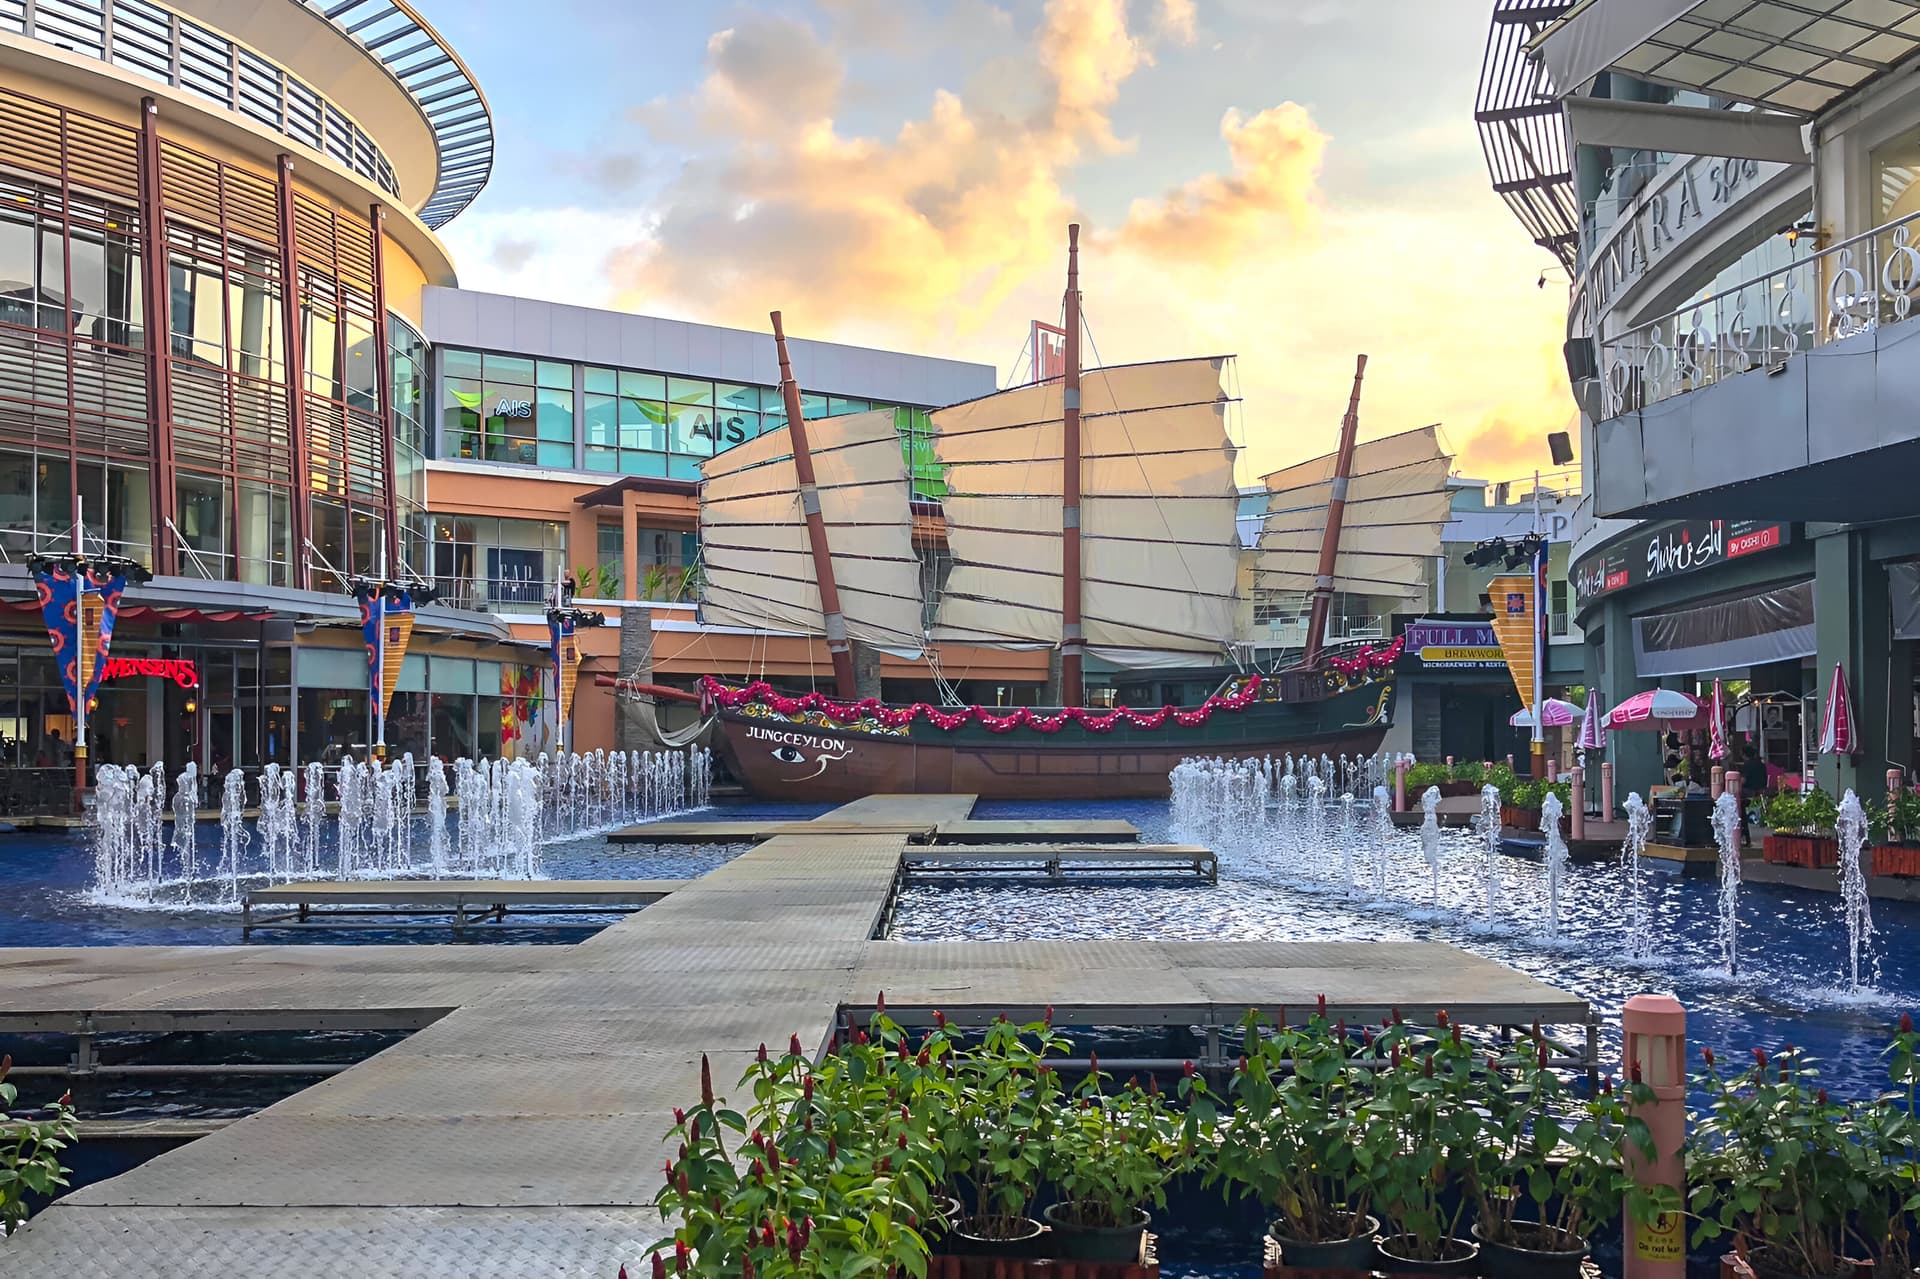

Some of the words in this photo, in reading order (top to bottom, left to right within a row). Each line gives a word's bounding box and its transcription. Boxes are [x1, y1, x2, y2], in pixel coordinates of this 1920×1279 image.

[495, 397, 532, 418] AIS
[689, 413, 746, 444] AIS
[1730, 543, 1739, 553] By
[1411, 629, 1468, 645] FULL
[746, 726, 845, 751] JUNGCEYLON
